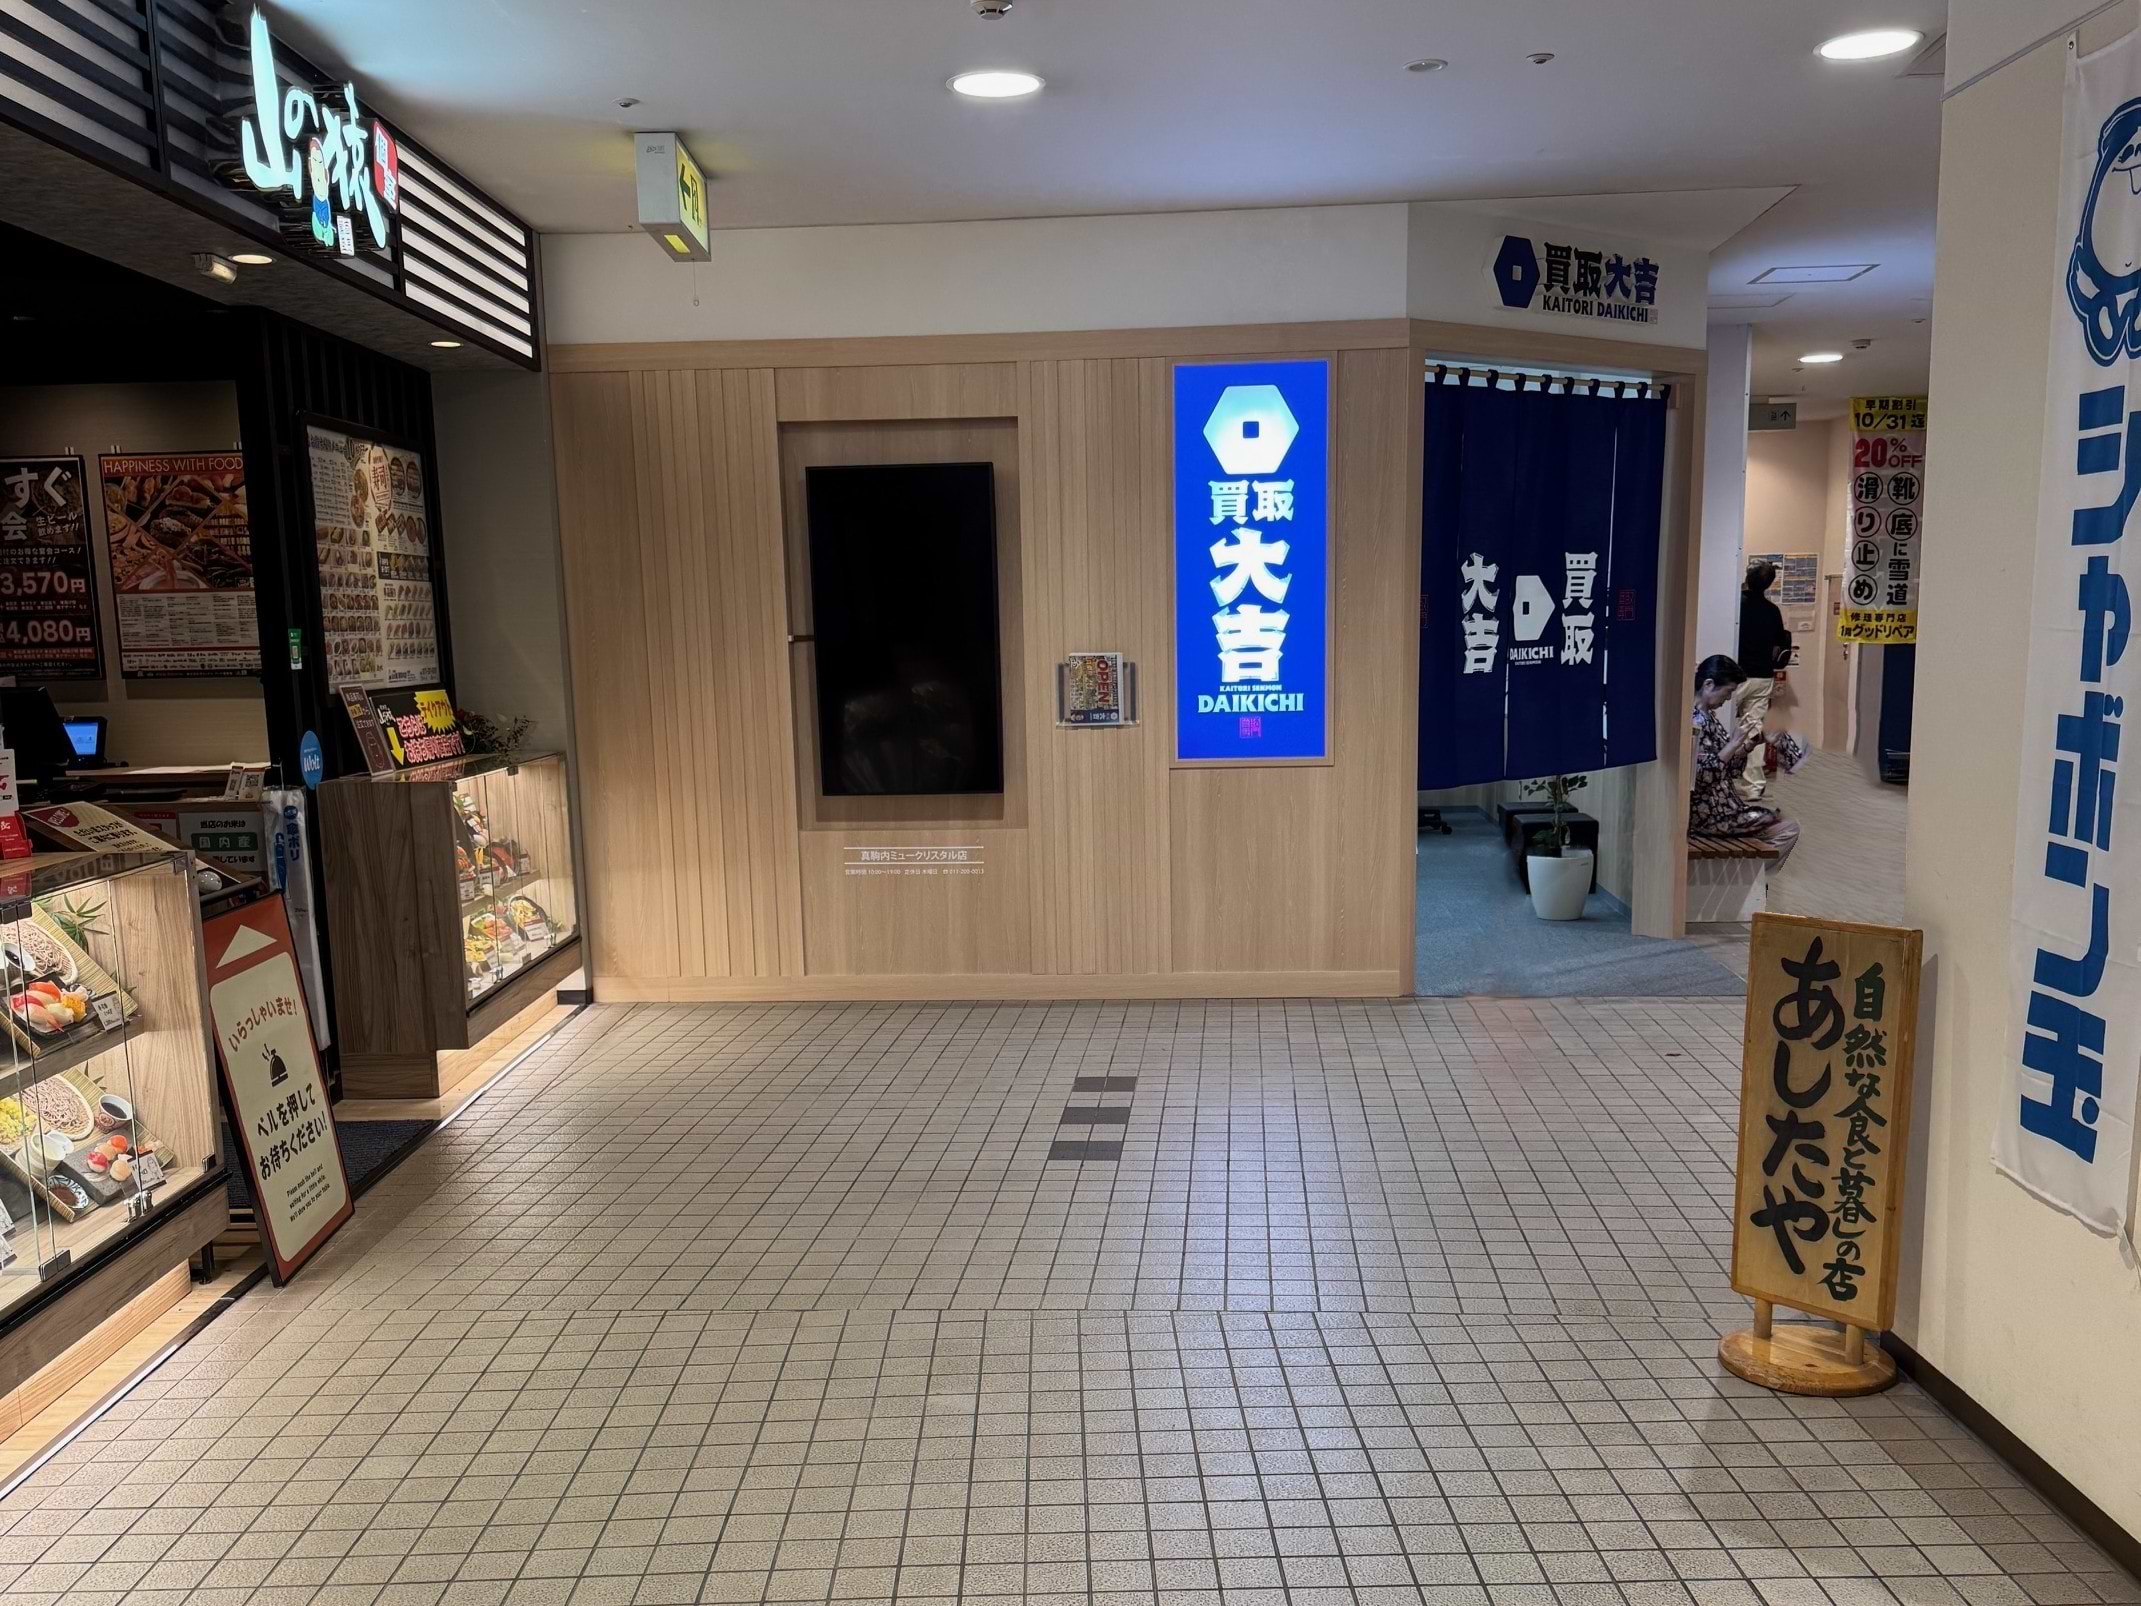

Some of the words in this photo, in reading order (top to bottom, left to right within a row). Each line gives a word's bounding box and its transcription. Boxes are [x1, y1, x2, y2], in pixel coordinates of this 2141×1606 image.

[242, 6, 386, 249] 山の猿
[1544, 242, 1659, 306] 買取大吉
[1543, 295, 1593, 316] KAITORI
[1597, 302, 1649, 323] DAIKICHI
[1864, 399, 1917, 410] 早期割引
[104, 459, 170, 473] HAPPINESS
[172, 458, 206, 471] WITH
[209, 457, 243, 470] FOOD
[1888, 454, 1922, 468] OFF
[4, 467, 72, 509] すぐ
[1208, 479, 1295, 525] 買取
[1, 511, 28, 540] 会
[36, 512, 77, 527] 生ビール
[1209, 526, 1292, 683] 大吉
[1461, 552, 1500, 674] 大吉
[1560, 551, 1598, 665] 買取
[1850, 612, 1906, 623] 修理専門店
[1509, 645, 1554, 661] DAIKICHI
[1096, 660, 1110, 703] OPEN
[1198, 692, 1305, 713] DAIKICHI
[303, 754, 321, 772] Wolt
[200, 820, 246, 829] 当店のお米は
[199, 835, 250, 848] 国内産
[256, 1082, 317, 1138] ベルを押して
[1750, 935, 1846, 1275] あしたや
